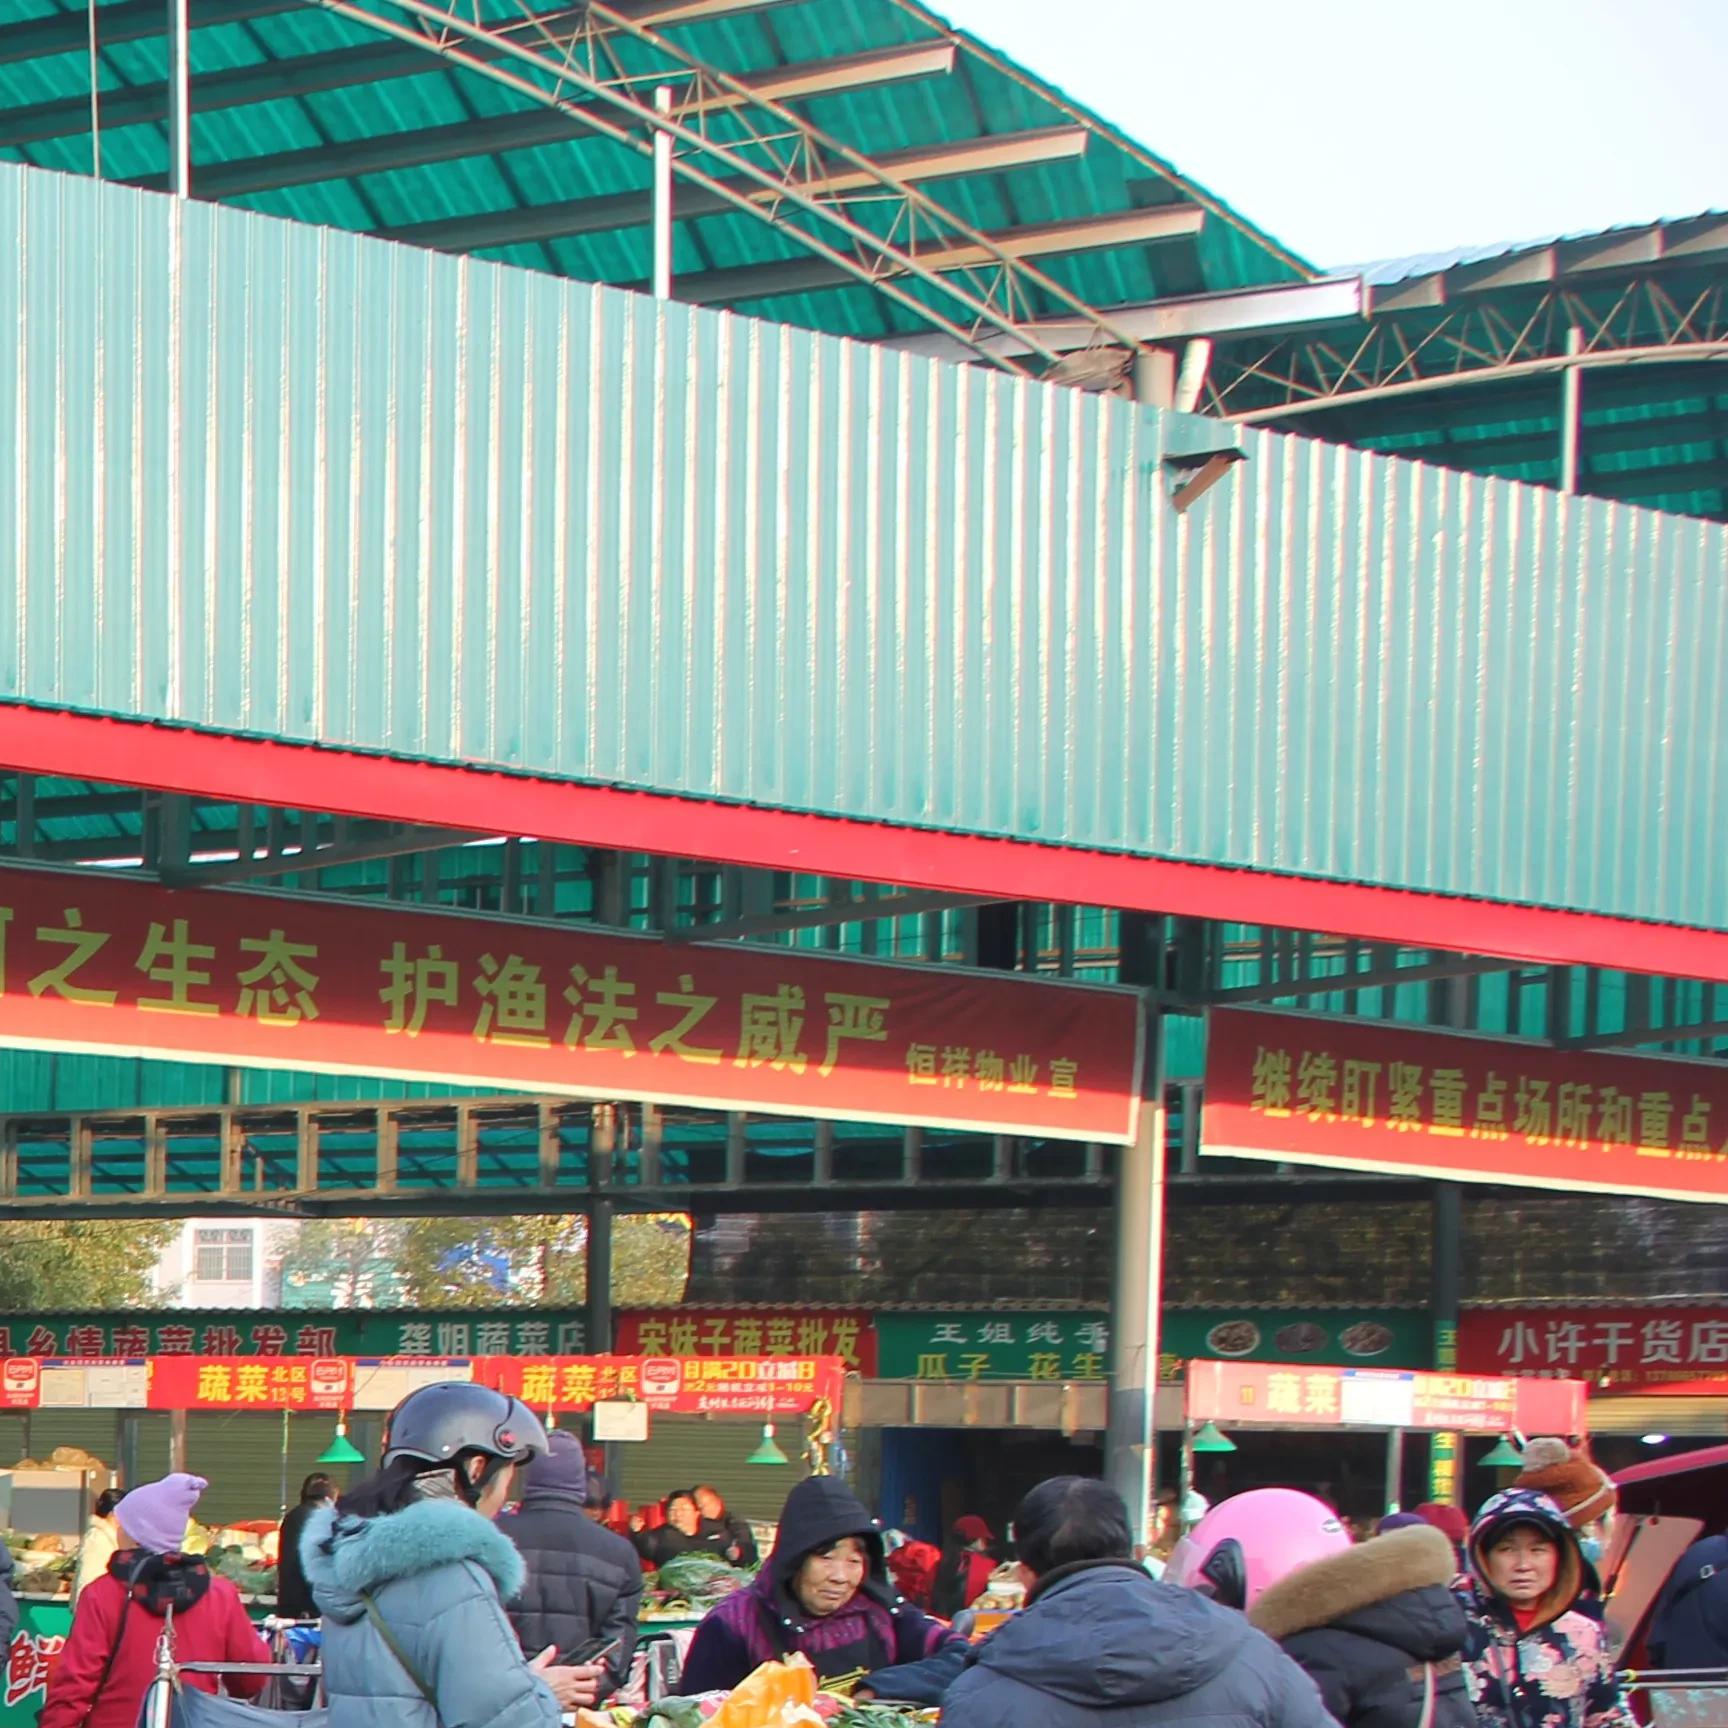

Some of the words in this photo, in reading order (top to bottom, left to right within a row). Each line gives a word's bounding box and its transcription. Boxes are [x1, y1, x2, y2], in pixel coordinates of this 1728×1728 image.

[378, 941, 892, 1077] 护渔法之威严
[905, 1042, 1038, 1096] 恒祥物业
[1048, 1057, 1079, 1099] 宣
[638, 1316, 861, 1365] 宋妹子蔬菜批发
[929, 1320, 1111, 1345] 王姐纯手
[1497, 1319, 1728, 1364] 小许干货店
[197, 1364, 269, 1402] 蔬菜
[271, 1366, 307, 1383] 北区
[520, 1363, 597, 1405] 蔬菜
[917, 1352, 991, 1379] 瓜子
[1028, 1352, 1106, 1379] 花生
[1265, 1371, 1341, 1416] 蔬菜
